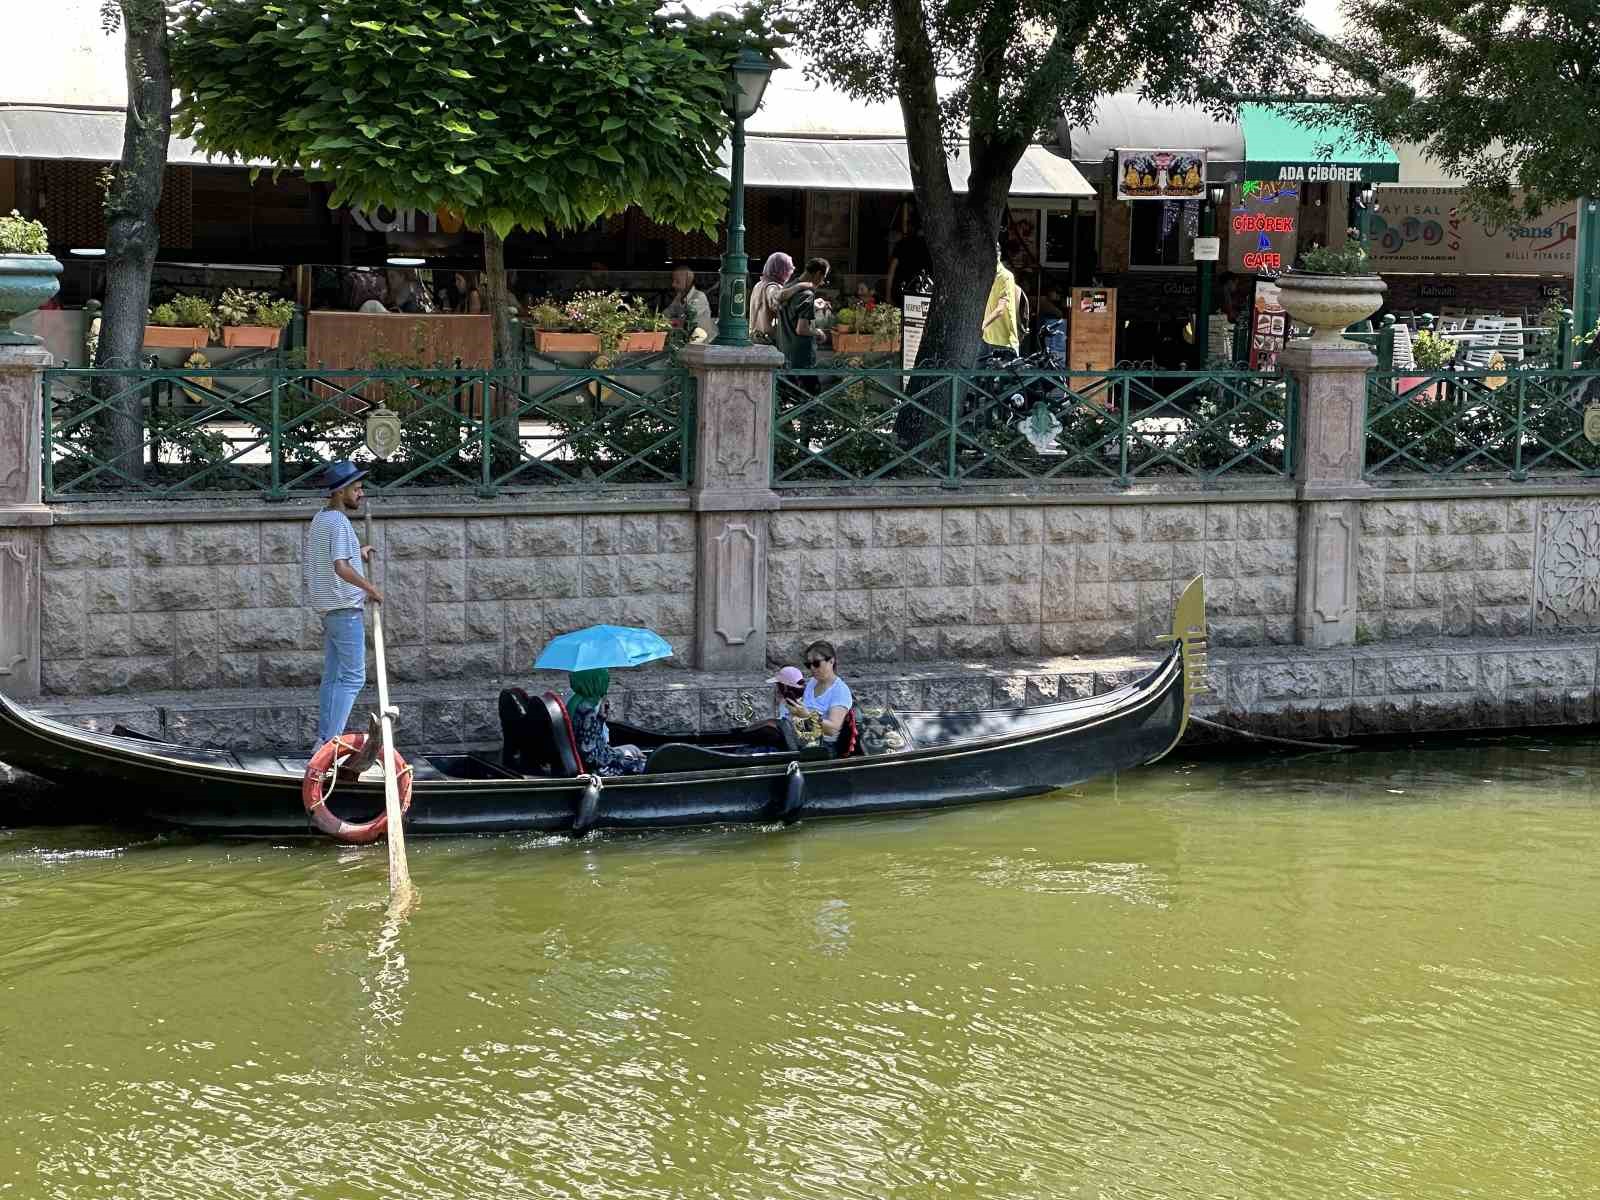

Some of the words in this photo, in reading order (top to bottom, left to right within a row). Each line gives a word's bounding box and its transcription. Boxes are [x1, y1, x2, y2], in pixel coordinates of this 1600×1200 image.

[1279, 167, 1306, 181] ADA
[1308, 164, 1362, 182] ÇİBÖREK
[1233, 213, 1294, 235] ÇİBÖREK
[1244, 252, 1281, 269] CAFE
